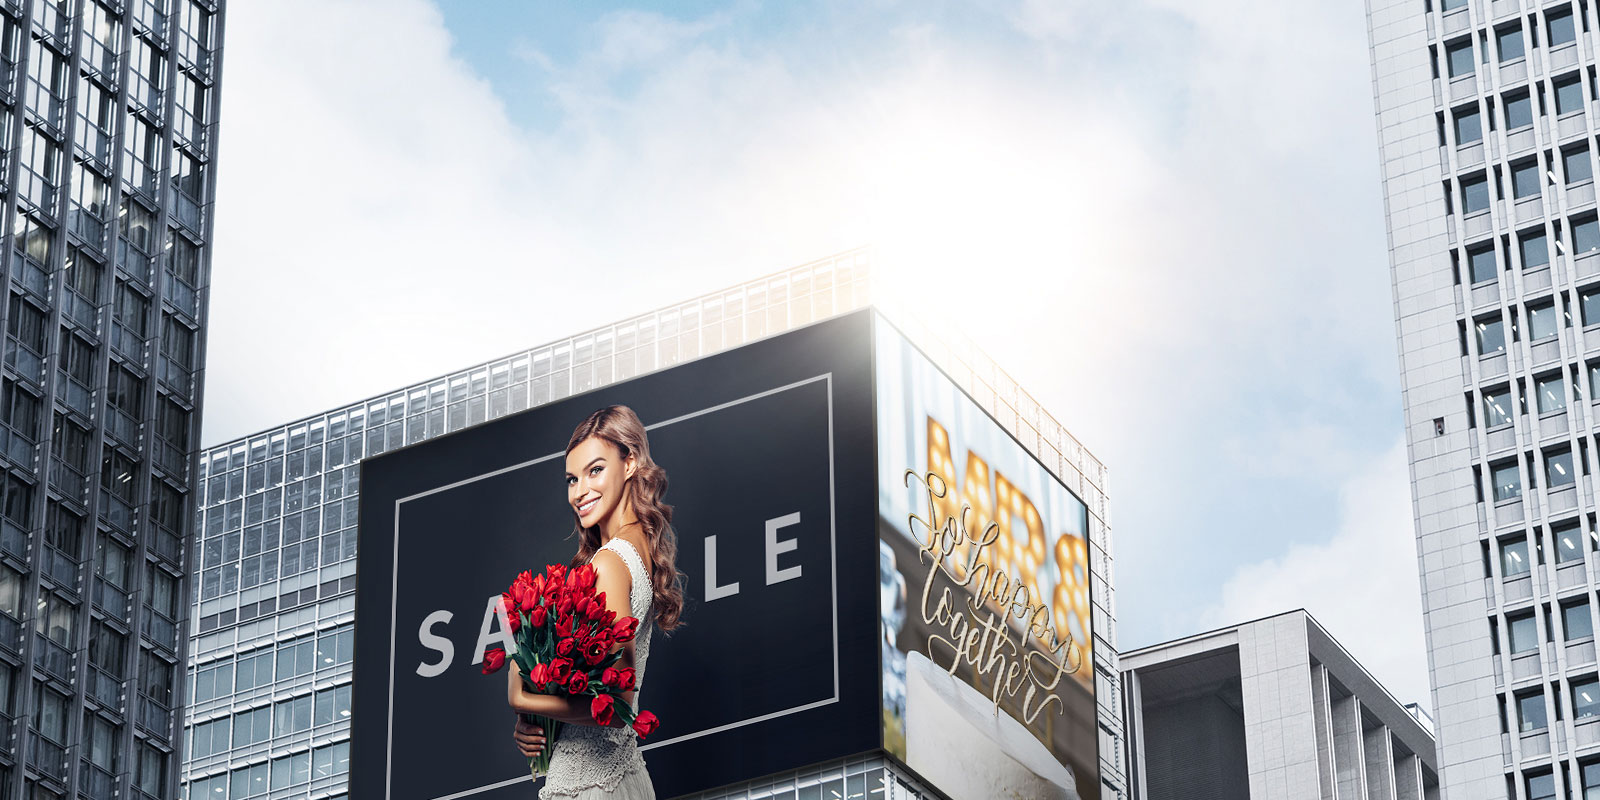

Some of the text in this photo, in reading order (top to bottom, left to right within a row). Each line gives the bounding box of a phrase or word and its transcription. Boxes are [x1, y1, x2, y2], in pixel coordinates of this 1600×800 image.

[904, 467, 1082, 691] So happy
[919, 545, 1064, 725] together
